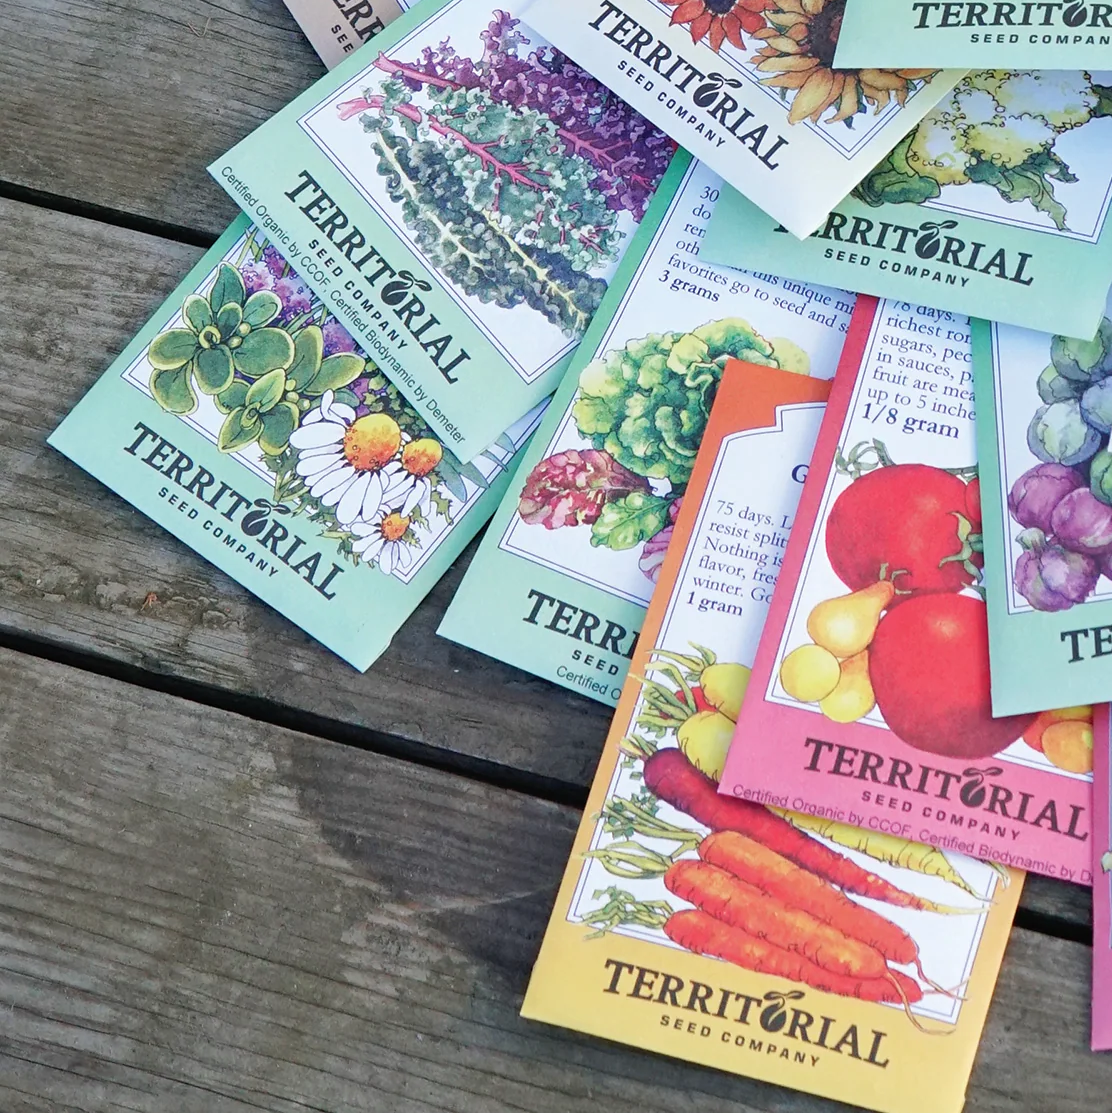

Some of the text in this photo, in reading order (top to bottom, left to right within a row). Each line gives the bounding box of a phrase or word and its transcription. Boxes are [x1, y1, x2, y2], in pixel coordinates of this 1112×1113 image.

[970, 34, 1019, 44] SEED
[588, 0, 789, 171] TERRITORIAL
[617, 60, 726, 148] SEED COMPANY
[700, 186, 719, 202] 30
[773, 212, 1034, 286] RRITORIAL
[284, 170, 471, 384] TERRITORIAL
[824, 248, 970, 288] SEED COMPANY
[220, 166, 465, 444] Certified Organic Certified Biodynamic Demeter
[308, 238, 408, 350] SEED COMPANY
[668, 253, 728, 286] favorites
[773, 296, 806, 315] seed
[808, 310, 837, 328] and
[670, 277, 720, 302] grams
[782, 280, 832, 305] unique
[886, 315, 941, 337] richest
[882, 334, 937, 357] sugars,
[872, 366, 938, 392] fruit are
[898, 356, 954, 379] sauces,
[867, 388, 911, 405] up to
[862, 402, 959, 438] 1/8 gram
[124, 422, 344, 601] TERRITORIAL
[716, 499, 734, 515] 75
[738, 506, 775, 526] days.
[158, 487, 279, 577] SEED COMPANY
[709, 521, 750, 539] resist
[698, 556, 746, 580] flavor,
[704, 536, 769, 568] Nothing
[693, 575, 744, 597] winter.
[698, 598, 743, 617] gram
[572, 650, 619, 676] SEED
[556, 666, 609, 695] Certified
[804, 737, 1090, 842] TERRITORIAL
[862, 790, 1021, 841] SEED COMPANY
[732, 784, 789, 808] Certified
[793, 798, 844, 820] Organic
[848, 811, 864, 827] by
[919, 829, 974, 853] Certified
[978, 845, 1056, 874] Biodynamic
[1060, 865, 1077, 881] by
[603, 958, 889, 1069] TERRITORIAL
[660, 1014, 821, 1068] SEED COMPANY
